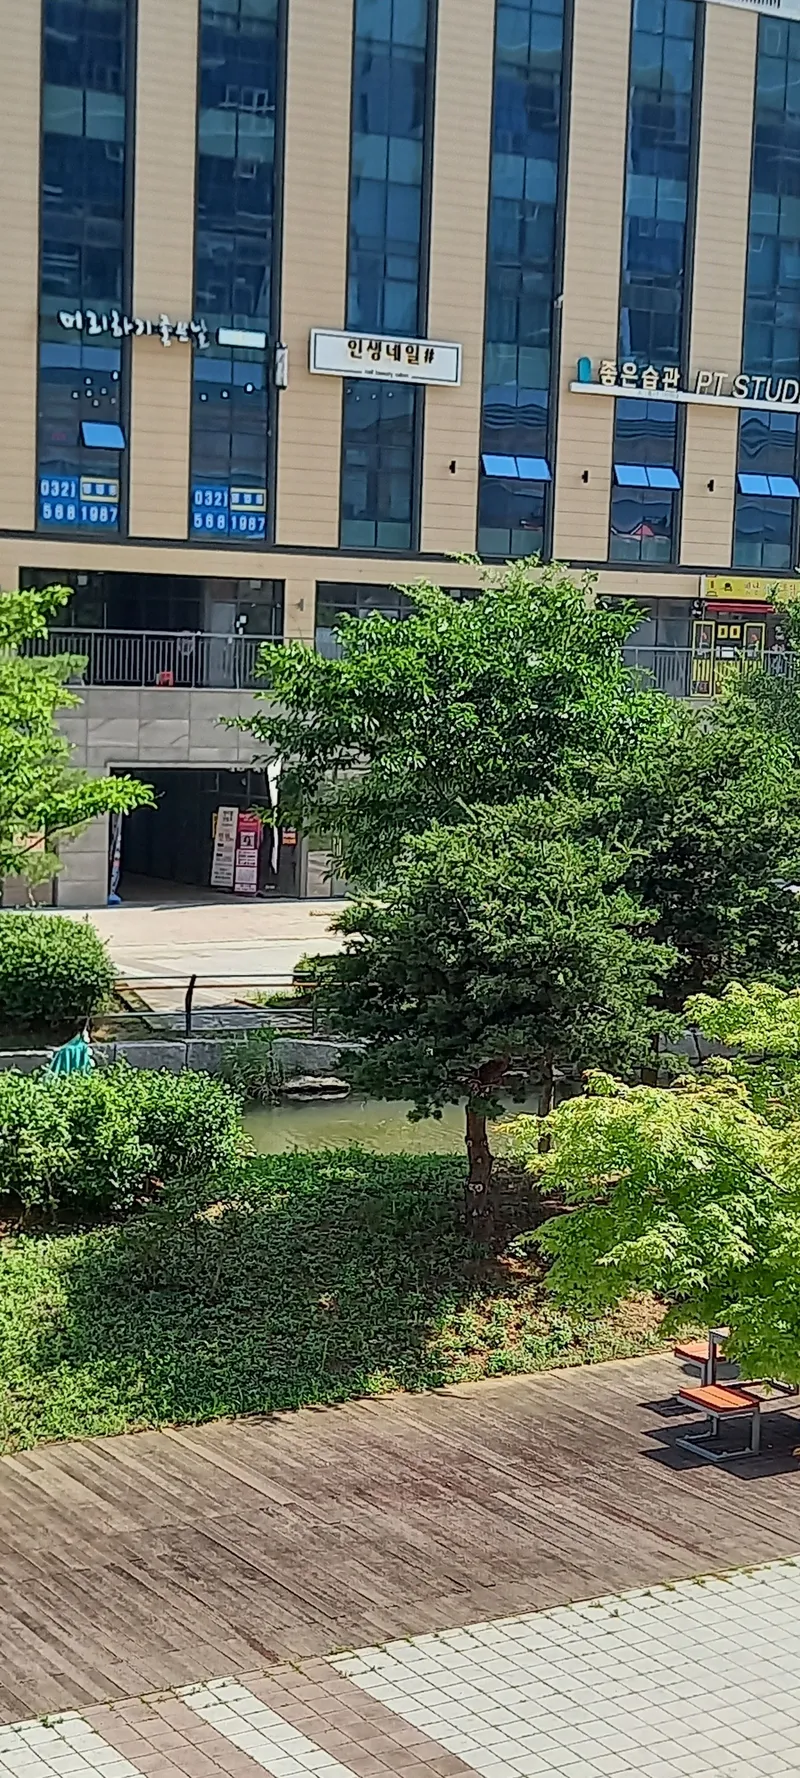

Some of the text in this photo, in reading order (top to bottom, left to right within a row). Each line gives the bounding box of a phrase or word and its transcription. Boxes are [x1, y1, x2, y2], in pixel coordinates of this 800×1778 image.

[347, 339, 435, 365] 인생네일#
[599, 360, 800, 404] 좋은습관 PT STUD
[81, 505, 118, 523] 1987
[230, 514, 266, 532] 1987
